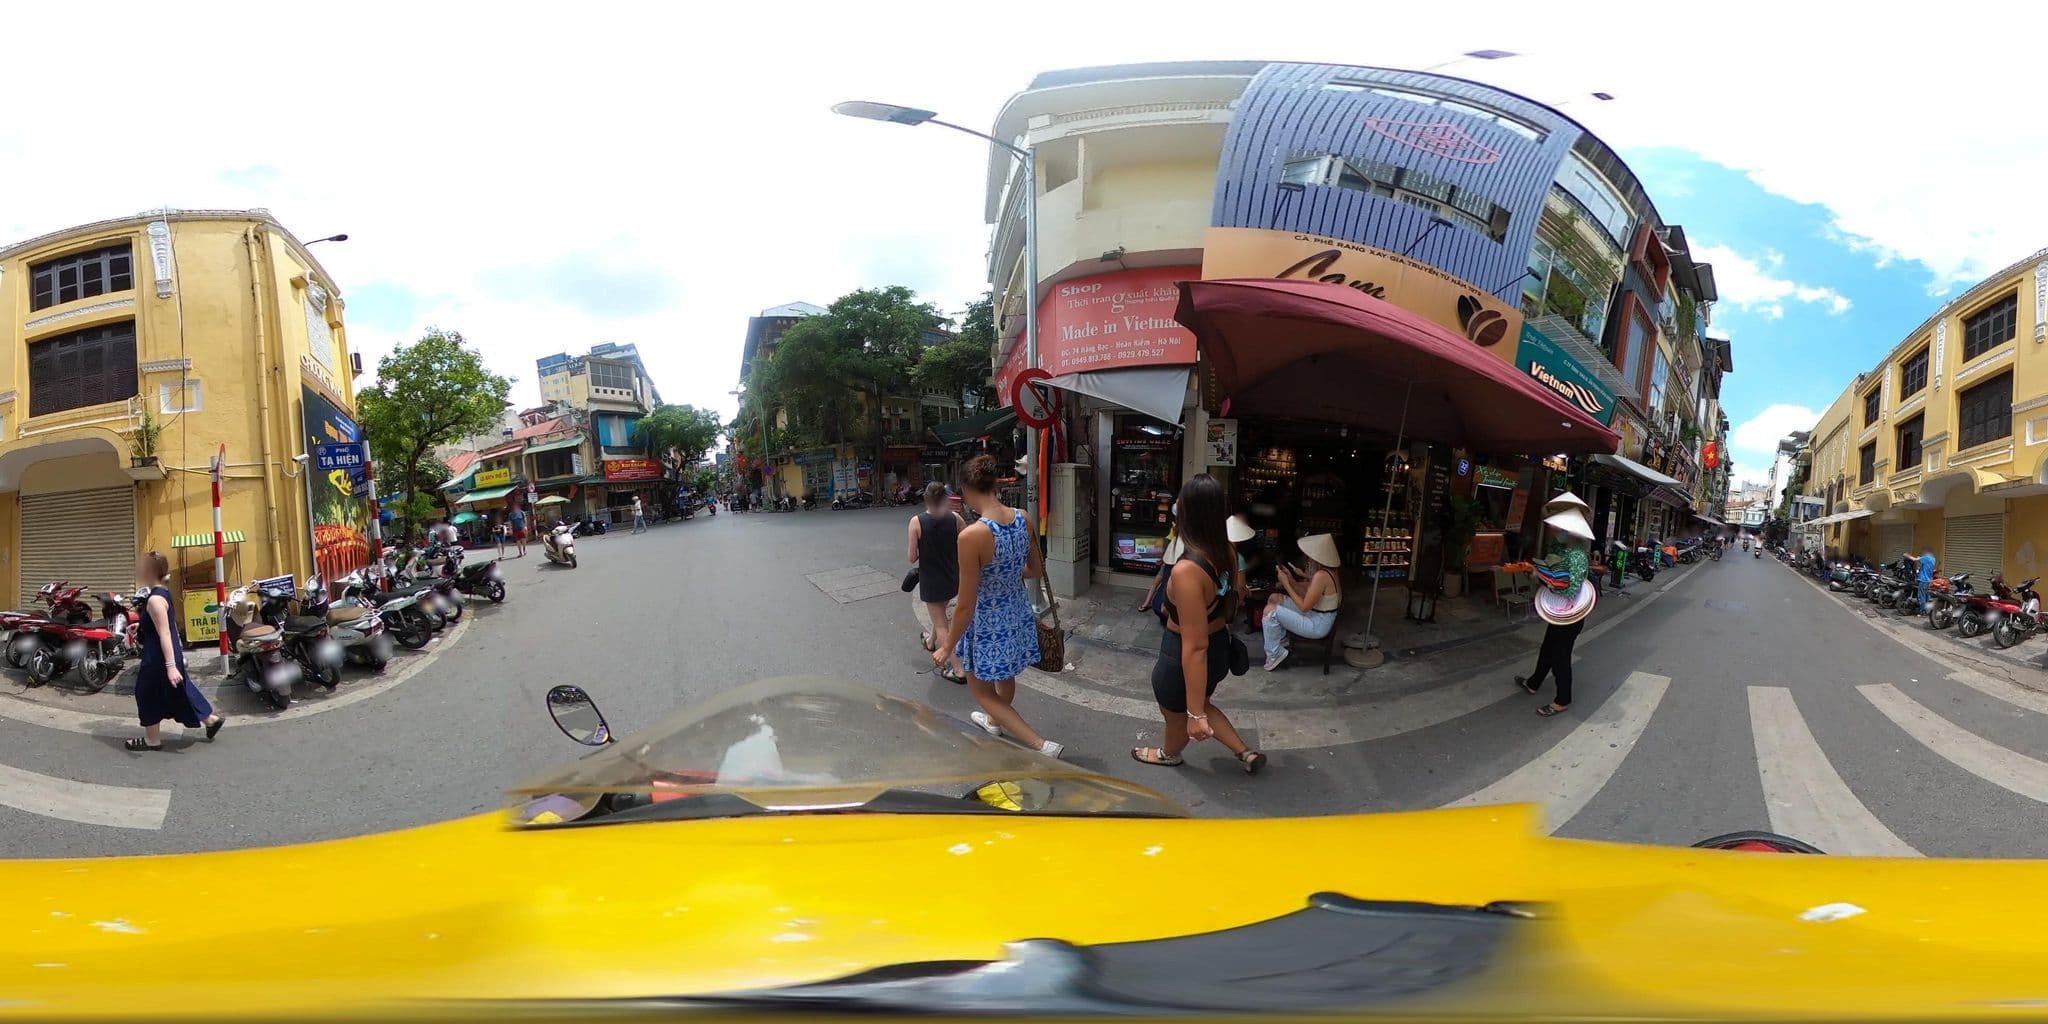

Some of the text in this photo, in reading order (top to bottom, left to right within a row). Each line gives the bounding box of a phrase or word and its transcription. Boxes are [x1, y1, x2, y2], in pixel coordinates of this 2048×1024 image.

[1313, 237, 1334, 246] PHÊ
[1336, 242, 1366, 253] RANG
[1369, 249, 1387, 259] XAY
[1390, 255, 1405, 265] GIA
[1060, 283, 1103, 298] Shop
[1062, 320, 1098, 342] Made
[1103, 319, 1117, 335] in
[1530, 360, 1575, 399] Vietnam
[335, 446, 350, 454] PHỐ
[320, 453, 360, 468] TẠ HIỆN
[190, 615, 208, 627] TRÀ
